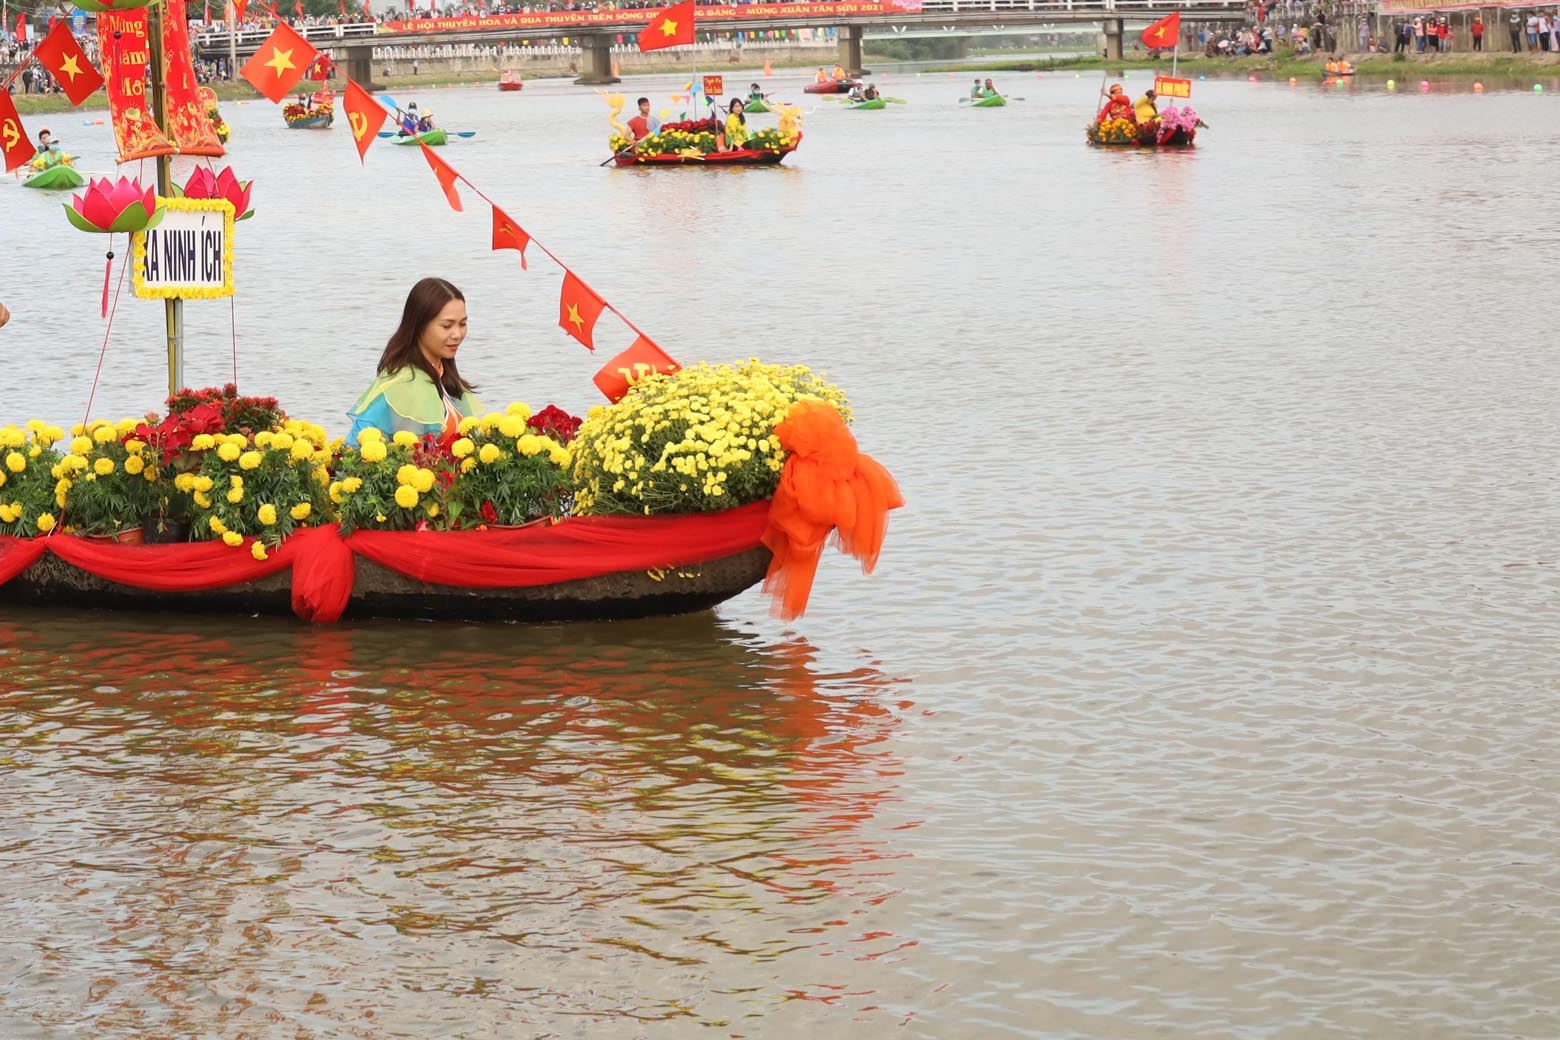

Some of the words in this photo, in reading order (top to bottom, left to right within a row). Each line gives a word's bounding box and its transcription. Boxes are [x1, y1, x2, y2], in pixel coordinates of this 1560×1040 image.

[417, 20, 435, 30] HỘI
[480, 18, 500, 26] HOA
[504, 16, 518, 25] VÀ
[520, 16, 542, 24] ĐUA
[587, 11, 613, 21] TRÊN
[615, 10, 643, 20] SÔNG
[781, 5, 810, 14] XUÂN
[813, 4, 834, 12] TÂN
[164, 230, 196, 281] NINH
[201, 216, 221, 282] ÍCH
